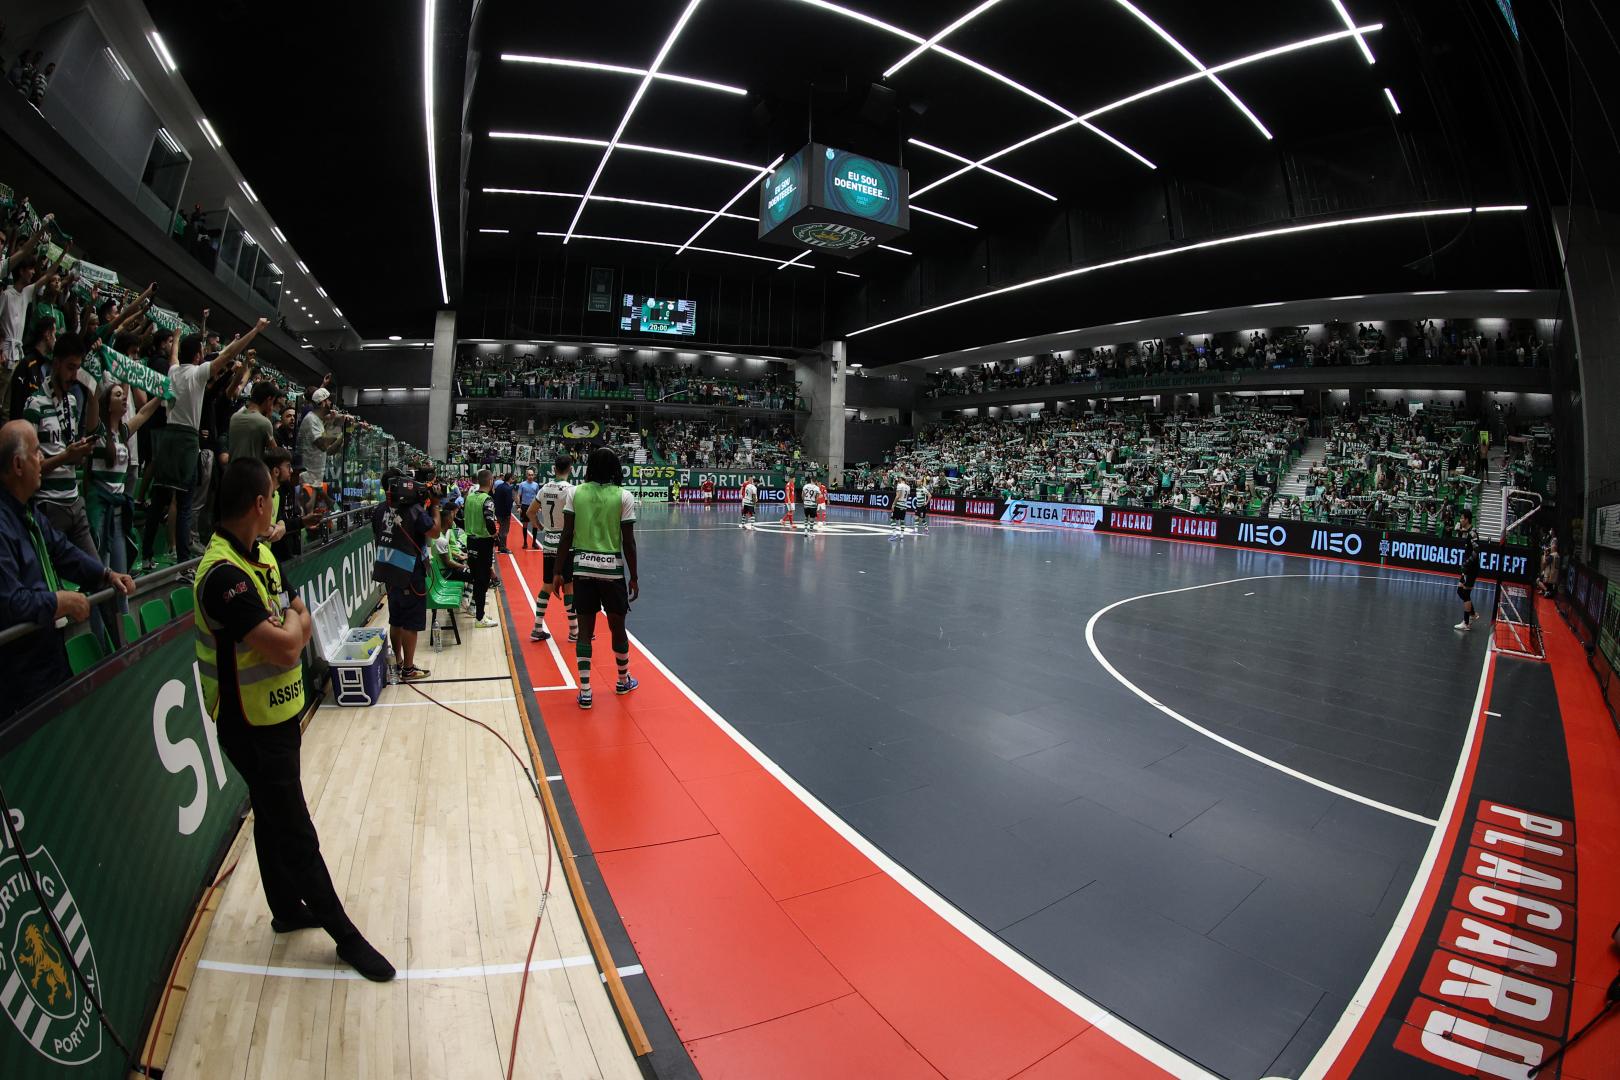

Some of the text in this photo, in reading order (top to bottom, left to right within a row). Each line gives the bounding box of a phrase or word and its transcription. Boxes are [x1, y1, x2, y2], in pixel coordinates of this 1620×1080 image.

[848, 171, 878, 187] EU SOU
[759, 490, 786, 500] MEO
[803, 488, 815, 498] 29
[869, 494, 889, 507] MEO
[929, 498, 955, 512] PLACARD
[965, 501, 995, 515] PLACARD
[546, 501, 555, 527] 7
[1030, 507, 1096, 526] LIGA PLACARD
[1110, 512, 1153, 531] PLACARD
[1170, 517, 1217, 538] PLACARD
[1238, 522, 1287, 547] MEO
[381, 535, 393, 543] FPF
[1310, 529, 1362, 555] MEO
[580, 553, 616, 564] Benecar
[1420, 804, 1563, 1080] PLACARD
